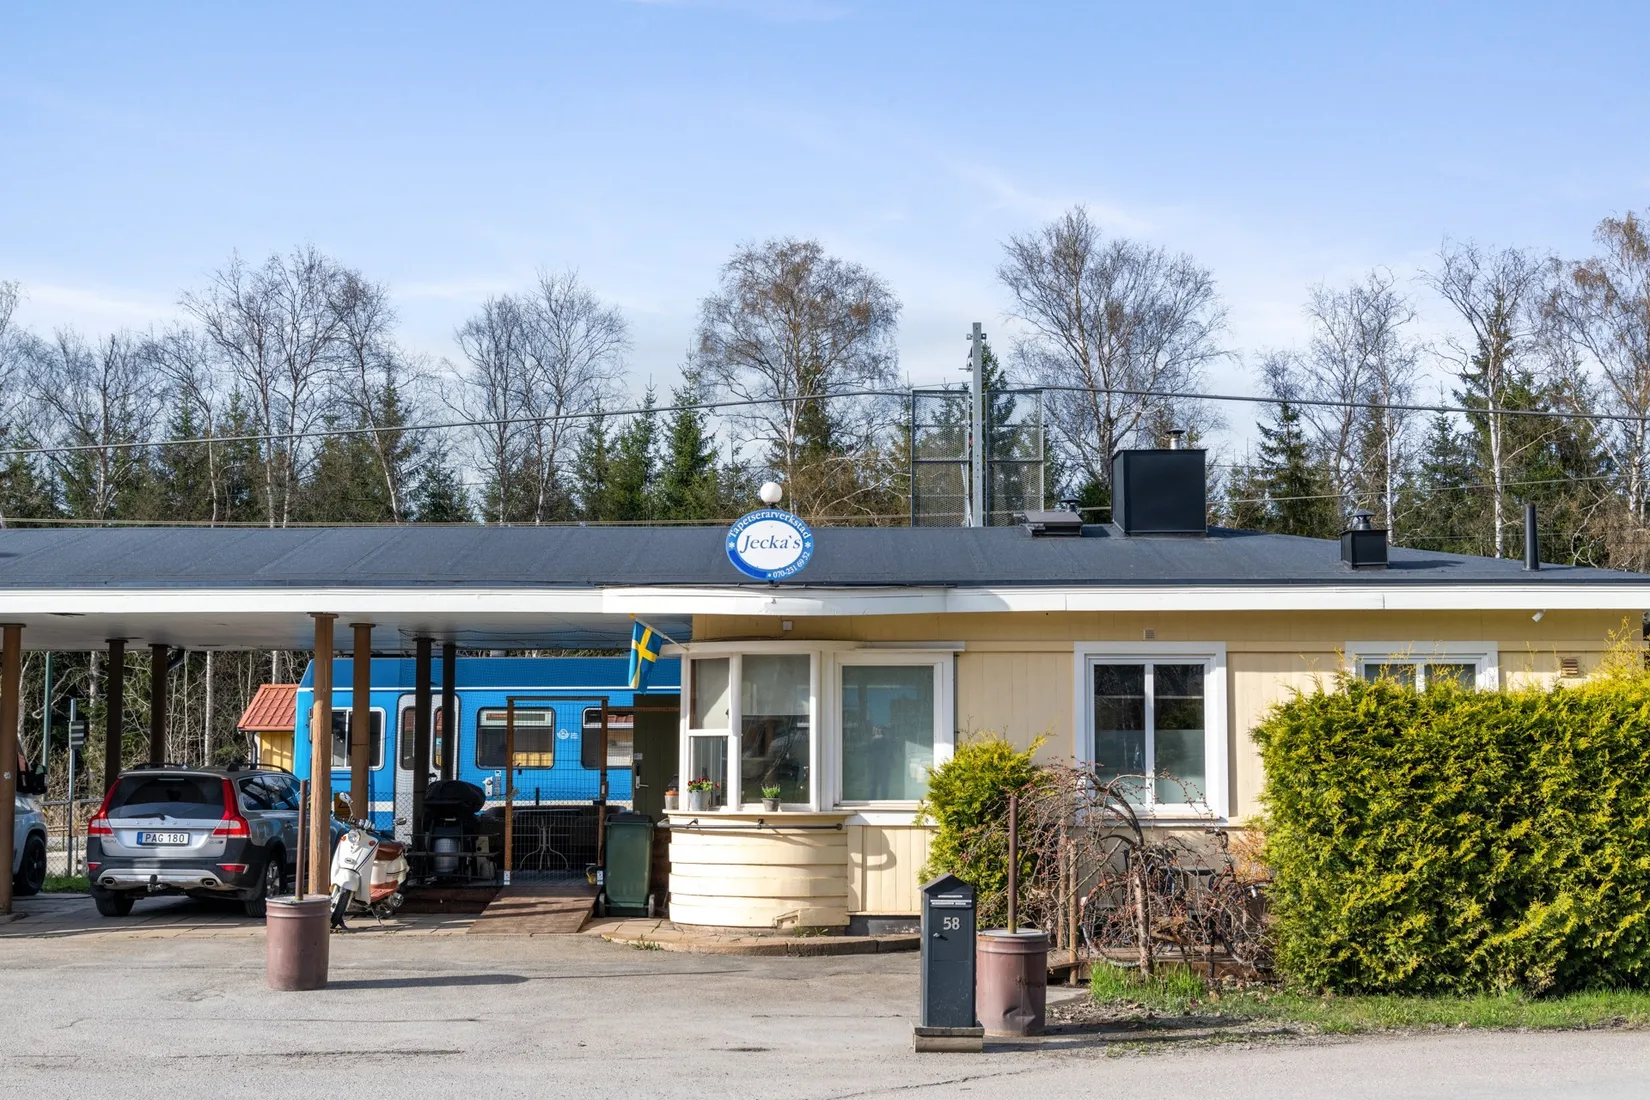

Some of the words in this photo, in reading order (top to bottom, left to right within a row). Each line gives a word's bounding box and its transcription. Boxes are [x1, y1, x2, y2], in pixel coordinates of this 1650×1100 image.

[728, 511, 812, 539] Tapetserarverkstad
[773, 565, 797, 578] 070-231
[145, 833, 164, 843] PAG
[168, 833, 185, 843] 180
[943, 917, 960, 930] 58
